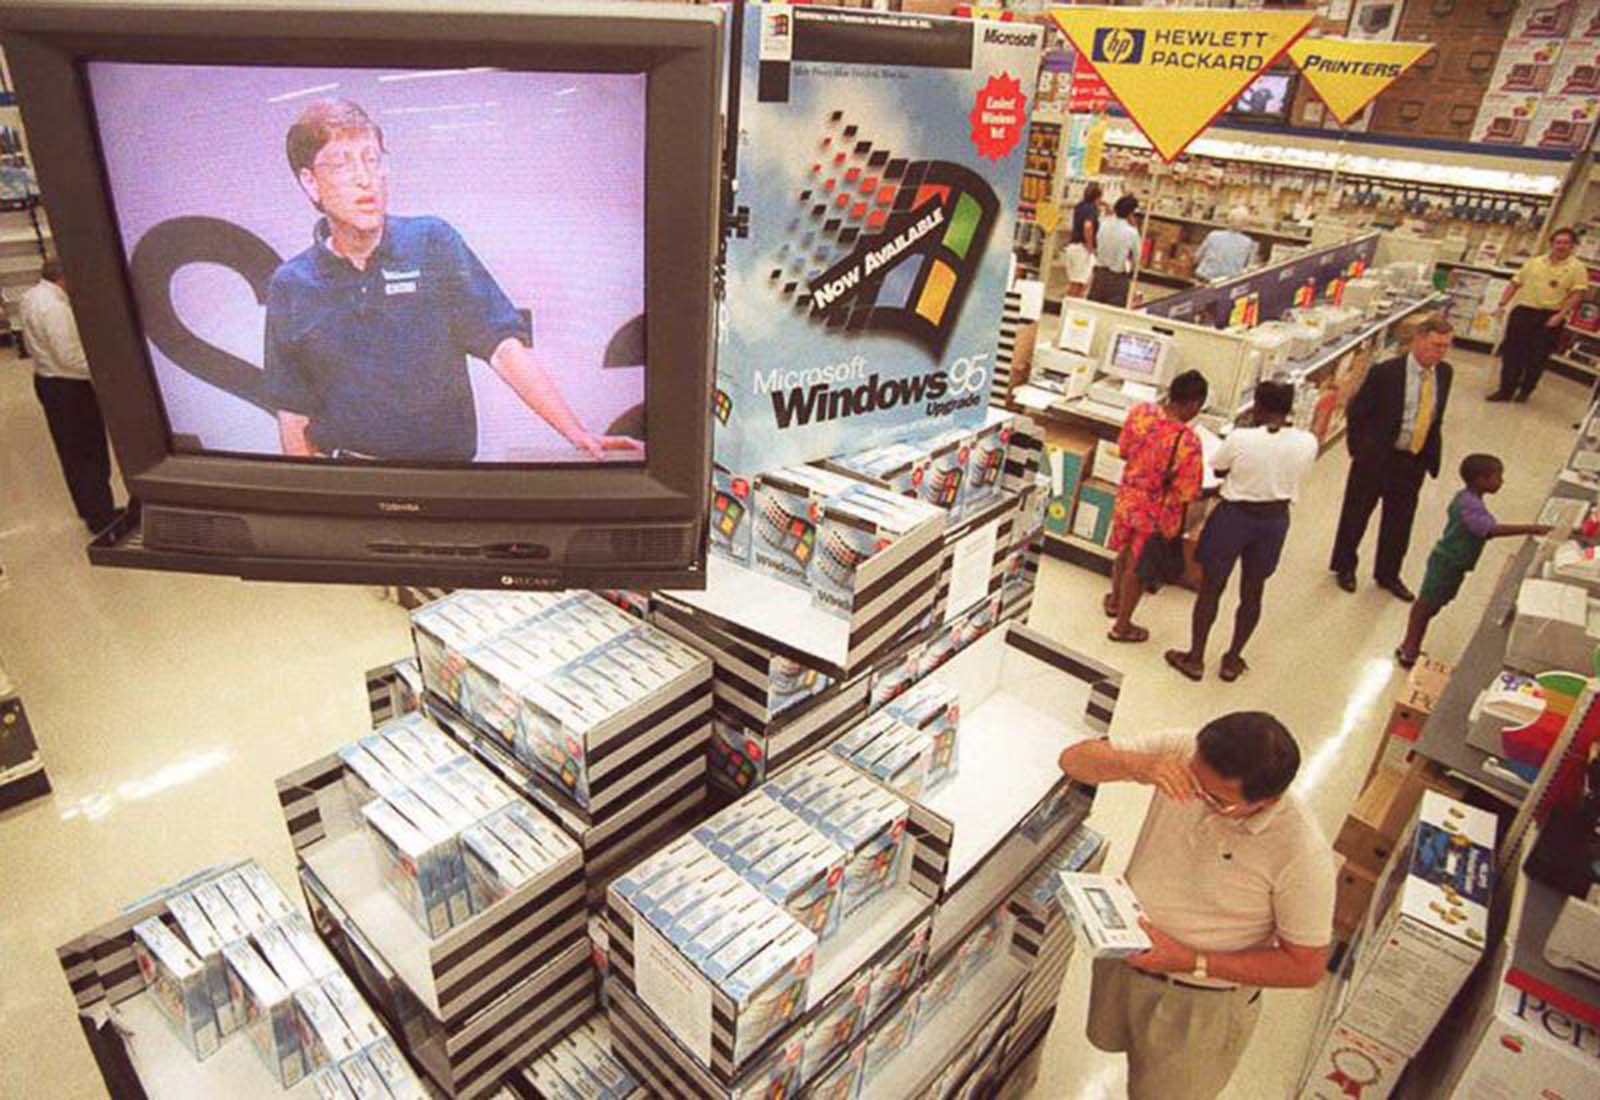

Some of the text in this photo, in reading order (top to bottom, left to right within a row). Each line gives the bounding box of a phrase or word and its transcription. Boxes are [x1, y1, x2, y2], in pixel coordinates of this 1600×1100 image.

[983, 28, 1038, 47] Microsoft
[1154, 28, 1269, 49] HEWLETT
[1150, 50, 1264, 72] PACKARD
[1303, 54, 1402, 77] PRINTERS
[753, 355, 868, 395] Microsoft
[771, 352, 990, 430] Windows 95
[925, 394, 982, 418] Upgrade
